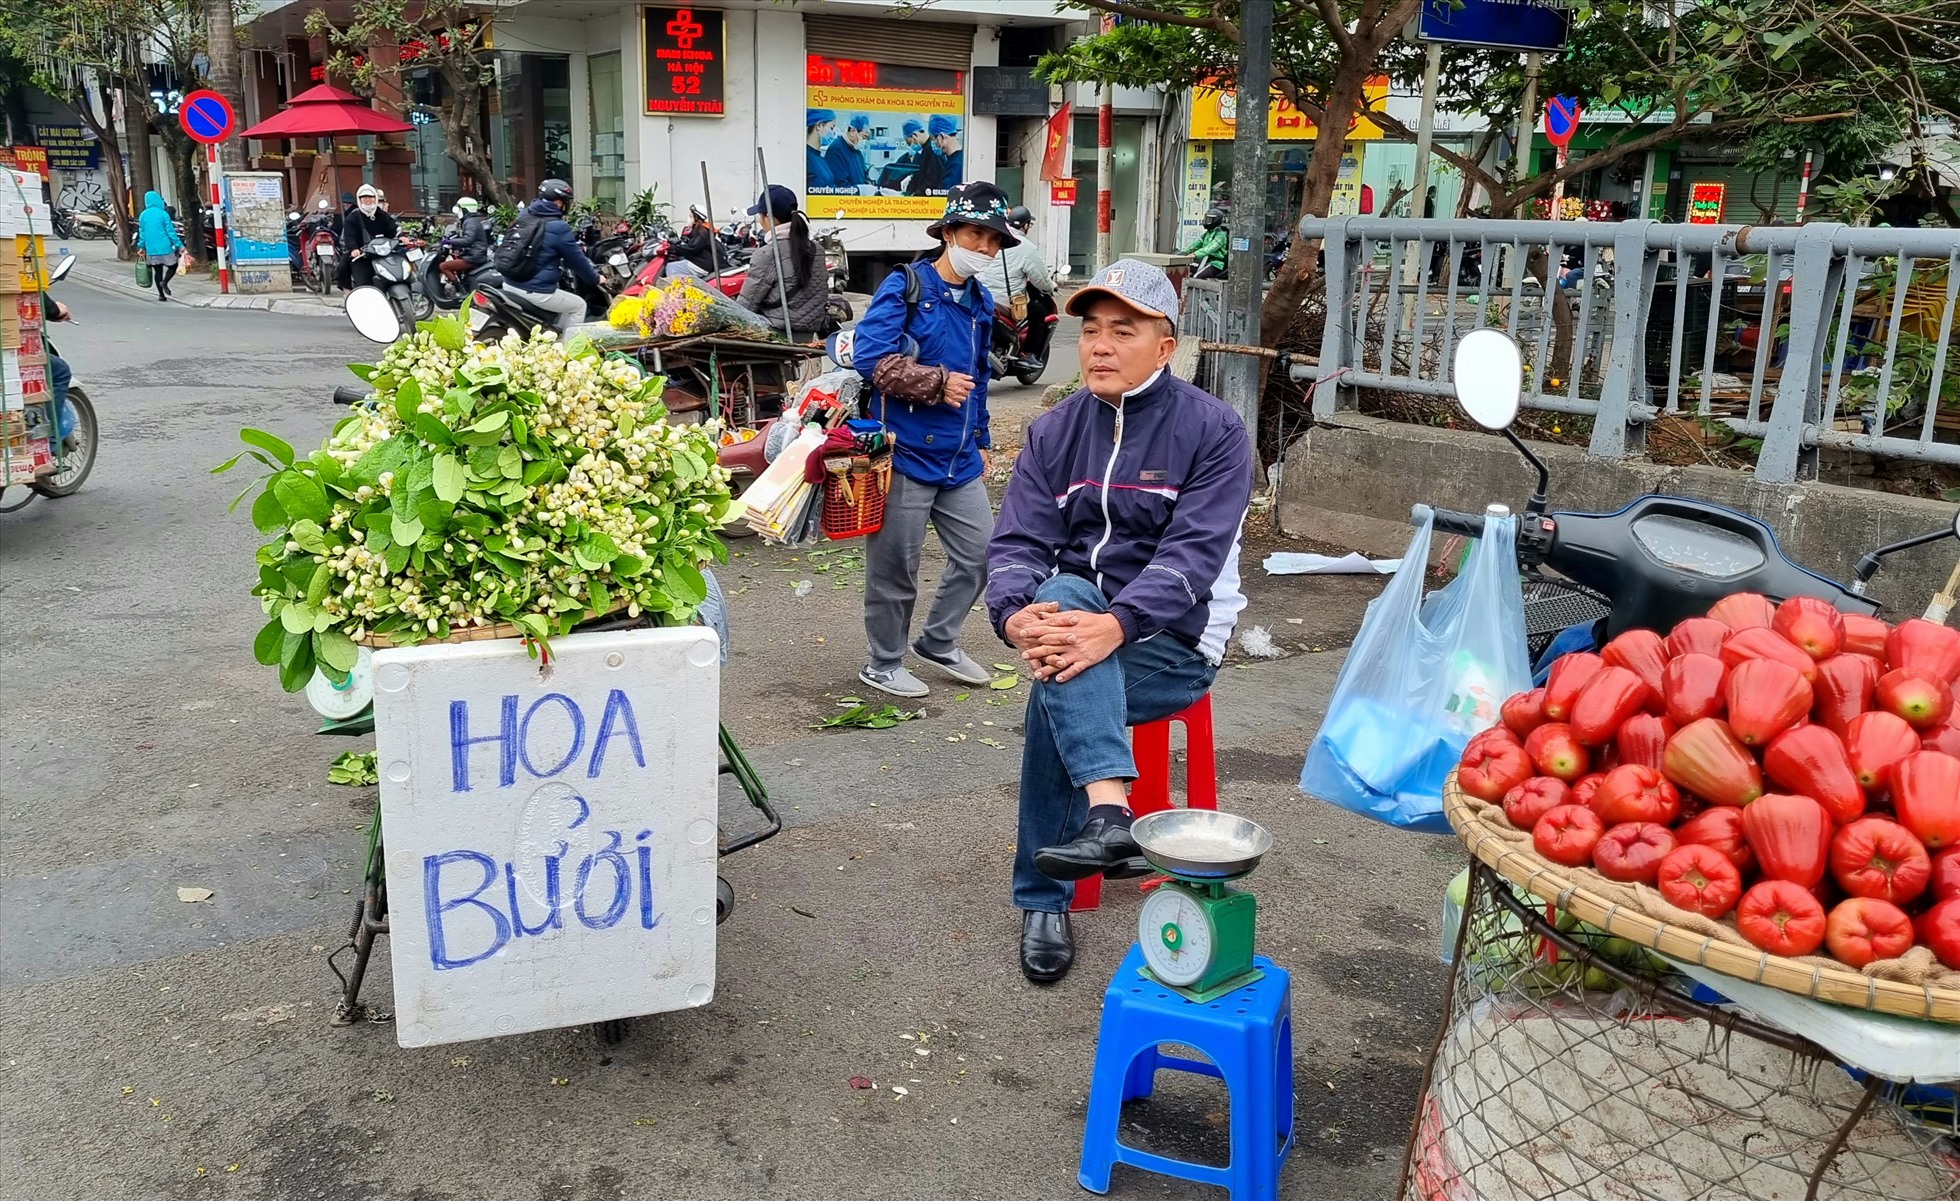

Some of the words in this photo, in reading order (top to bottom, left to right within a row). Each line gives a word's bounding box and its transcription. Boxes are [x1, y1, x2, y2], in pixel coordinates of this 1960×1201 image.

[656, 49, 681, 59] NAM
[682, 50, 713, 60] KHOA
[667, 61, 683, 72] HÀ
[684, 62, 704, 75] NỘI
[671, 75, 701, 94] 52
[649, 96, 695, 112] NGUYỄN
[696, 99, 722, 113] TRÃI
[831, 95, 855, 105] PHÒNG
[856, 96, 875, 106] KHÁM
[876, 98, 887, 106] ĐA
[887, 99, 906, 107] KHOA
[907, 100, 914, 108] 52
[915, 98, 941, 109] NGUYỄN
[942, 100, 956, 109] TRÃI
[26, 162, 39, 172] XE
[808, 186, 834, 194] CHUYÊN
[834, 187, 858, 196] NGHIỆP
[839, 198, 861, 206] CHUYÊN
[863, 199, 884, 207] NGHIỆP
[912, 200, 929, 208] NHIỆM
[847, 207, 868, 216] NGHIỆP
[911, 207, 929, 215] NGƯỜI
[448, 688, 647, 793] HOA
